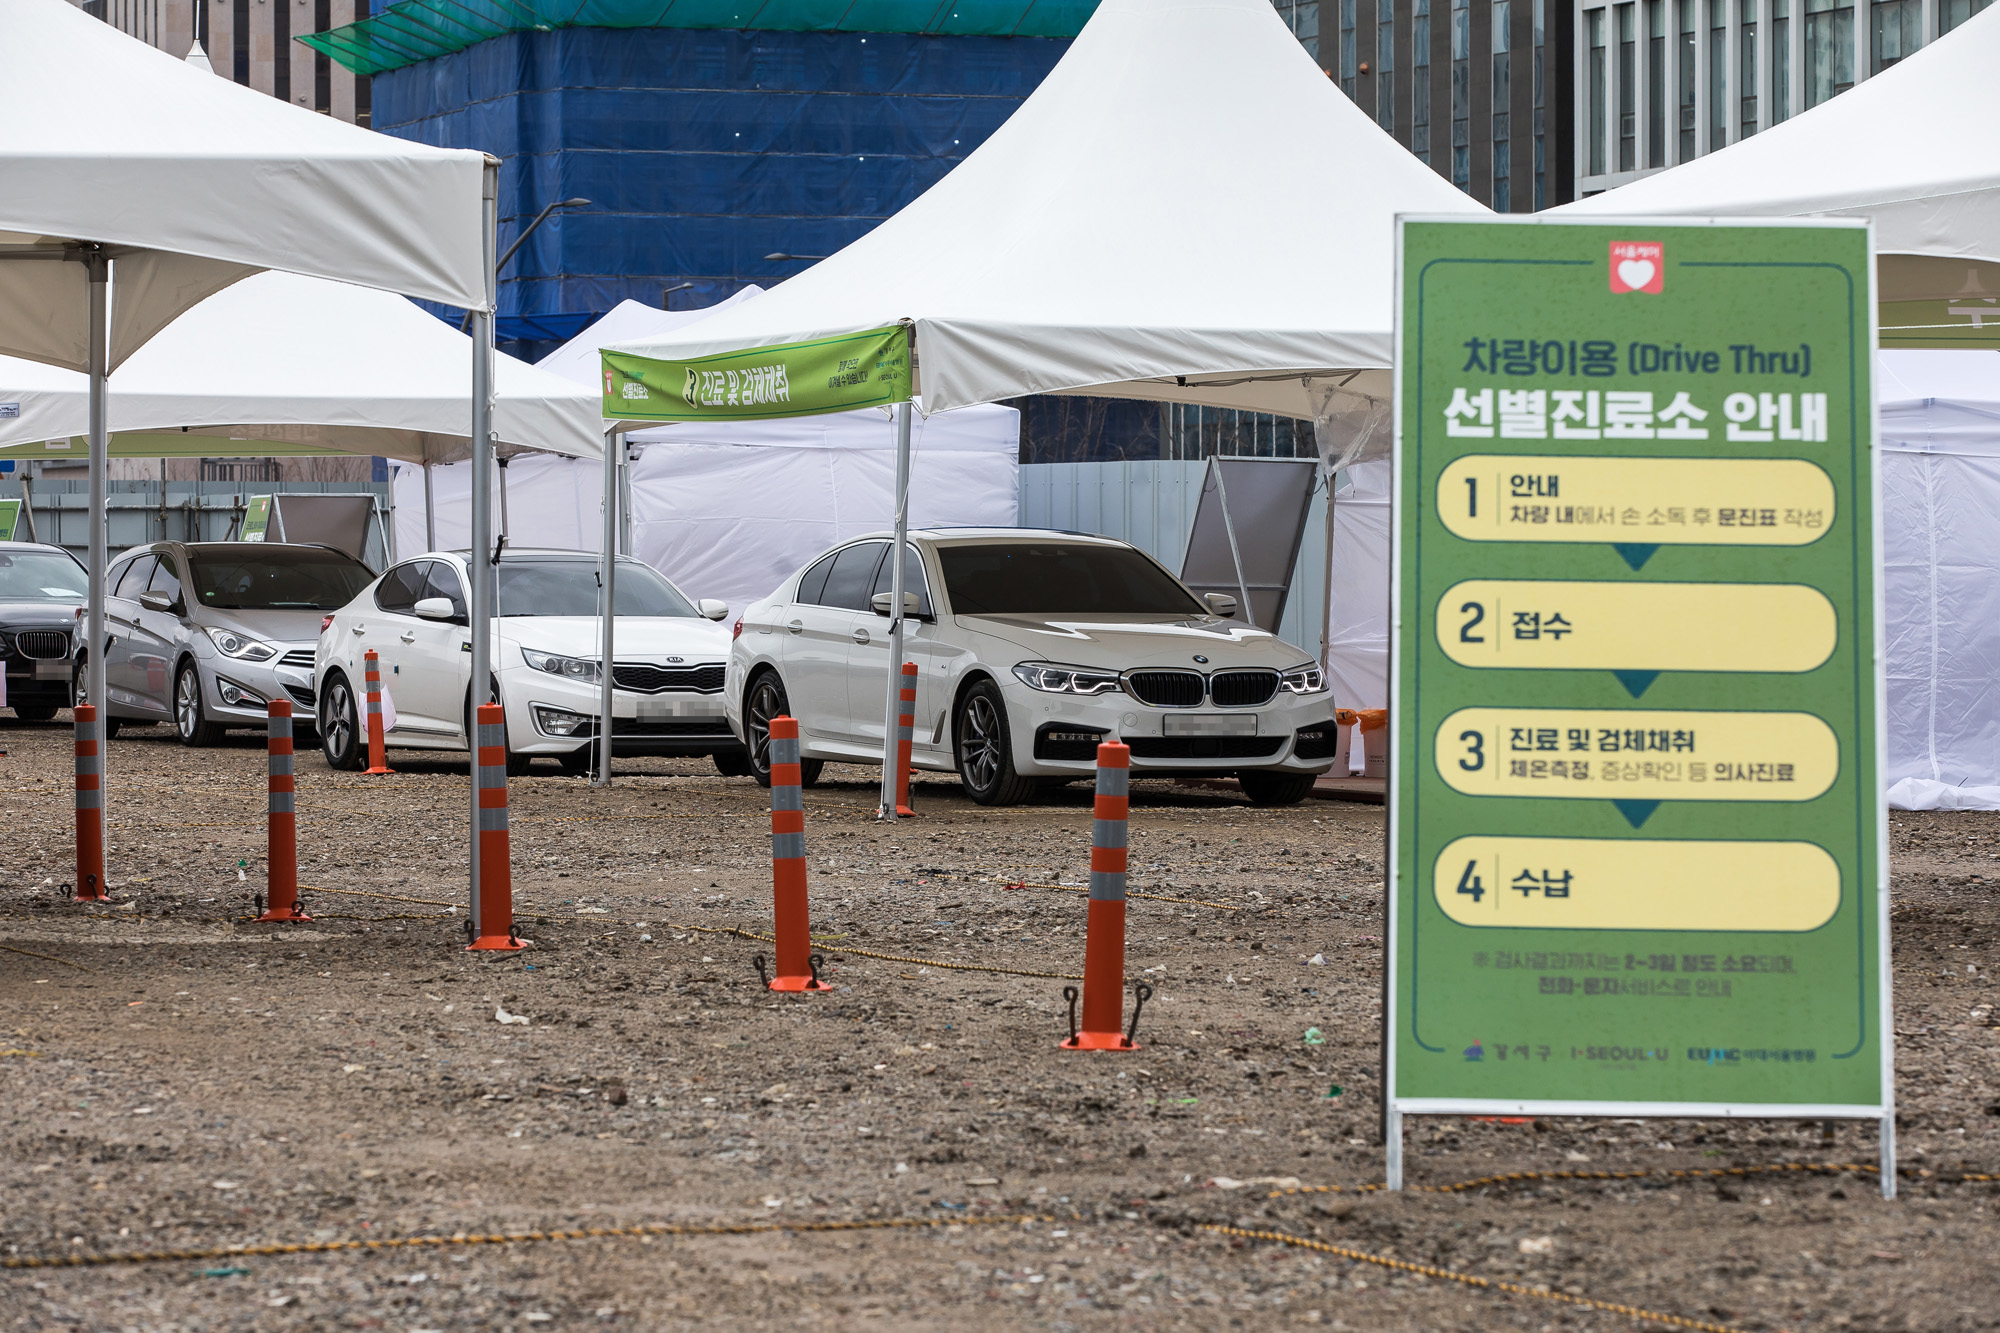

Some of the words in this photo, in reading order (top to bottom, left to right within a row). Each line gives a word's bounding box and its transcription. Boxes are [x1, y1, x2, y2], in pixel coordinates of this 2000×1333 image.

[1613, 244, 1660, 259] 서울케어
[1462, 336, 1618, 377] 차량이용
[1628, 342, 1721, 376] (Drive
[1728, 343, 1812, 378] Thru)
[622, 382, 649, 400] 선별진료소
[701, 370, 725, 406] 진료
[725, 369, 740, 407] 및
[740, 363, 791, 406] 검체채취
[1443, 387, 1709, 440] 선별진료소
[1723, 392, 1828, 443] 안내
[1465, 477, 1477, 518] 1
[1510, 474, 1559, 498] 안내
[1510, 504, 1550, 524] 차량
[1556, 505, 1615, 525] 내에서
[1621, 507, 1640, 527] 손
[1646, 506, 1686, 526] 소독
[1692, 507, 1712, 526] 후
[1717, 508, 1777, 527] 문진표
[1783, 509, 1824, 530] 작성
[1460, 602, 1485, 643] 2
[1512, 612, 1573, 641] 접수
[1458, 730, 1485, 772] 3
[1510, 727, 1560, 752] 진료
[1567, 728, 1590, 752] 및
[1597, 728, 1696, 753] 검체채취
[1601, 760, 1682, 782] 증상확인
[1688, 761, 1709, 783] 등
[1714, 762, 1796, 783] 의사진료
[1456, 859, 1486, 903] 4
[1511, 868, 1574, 899] 수납
